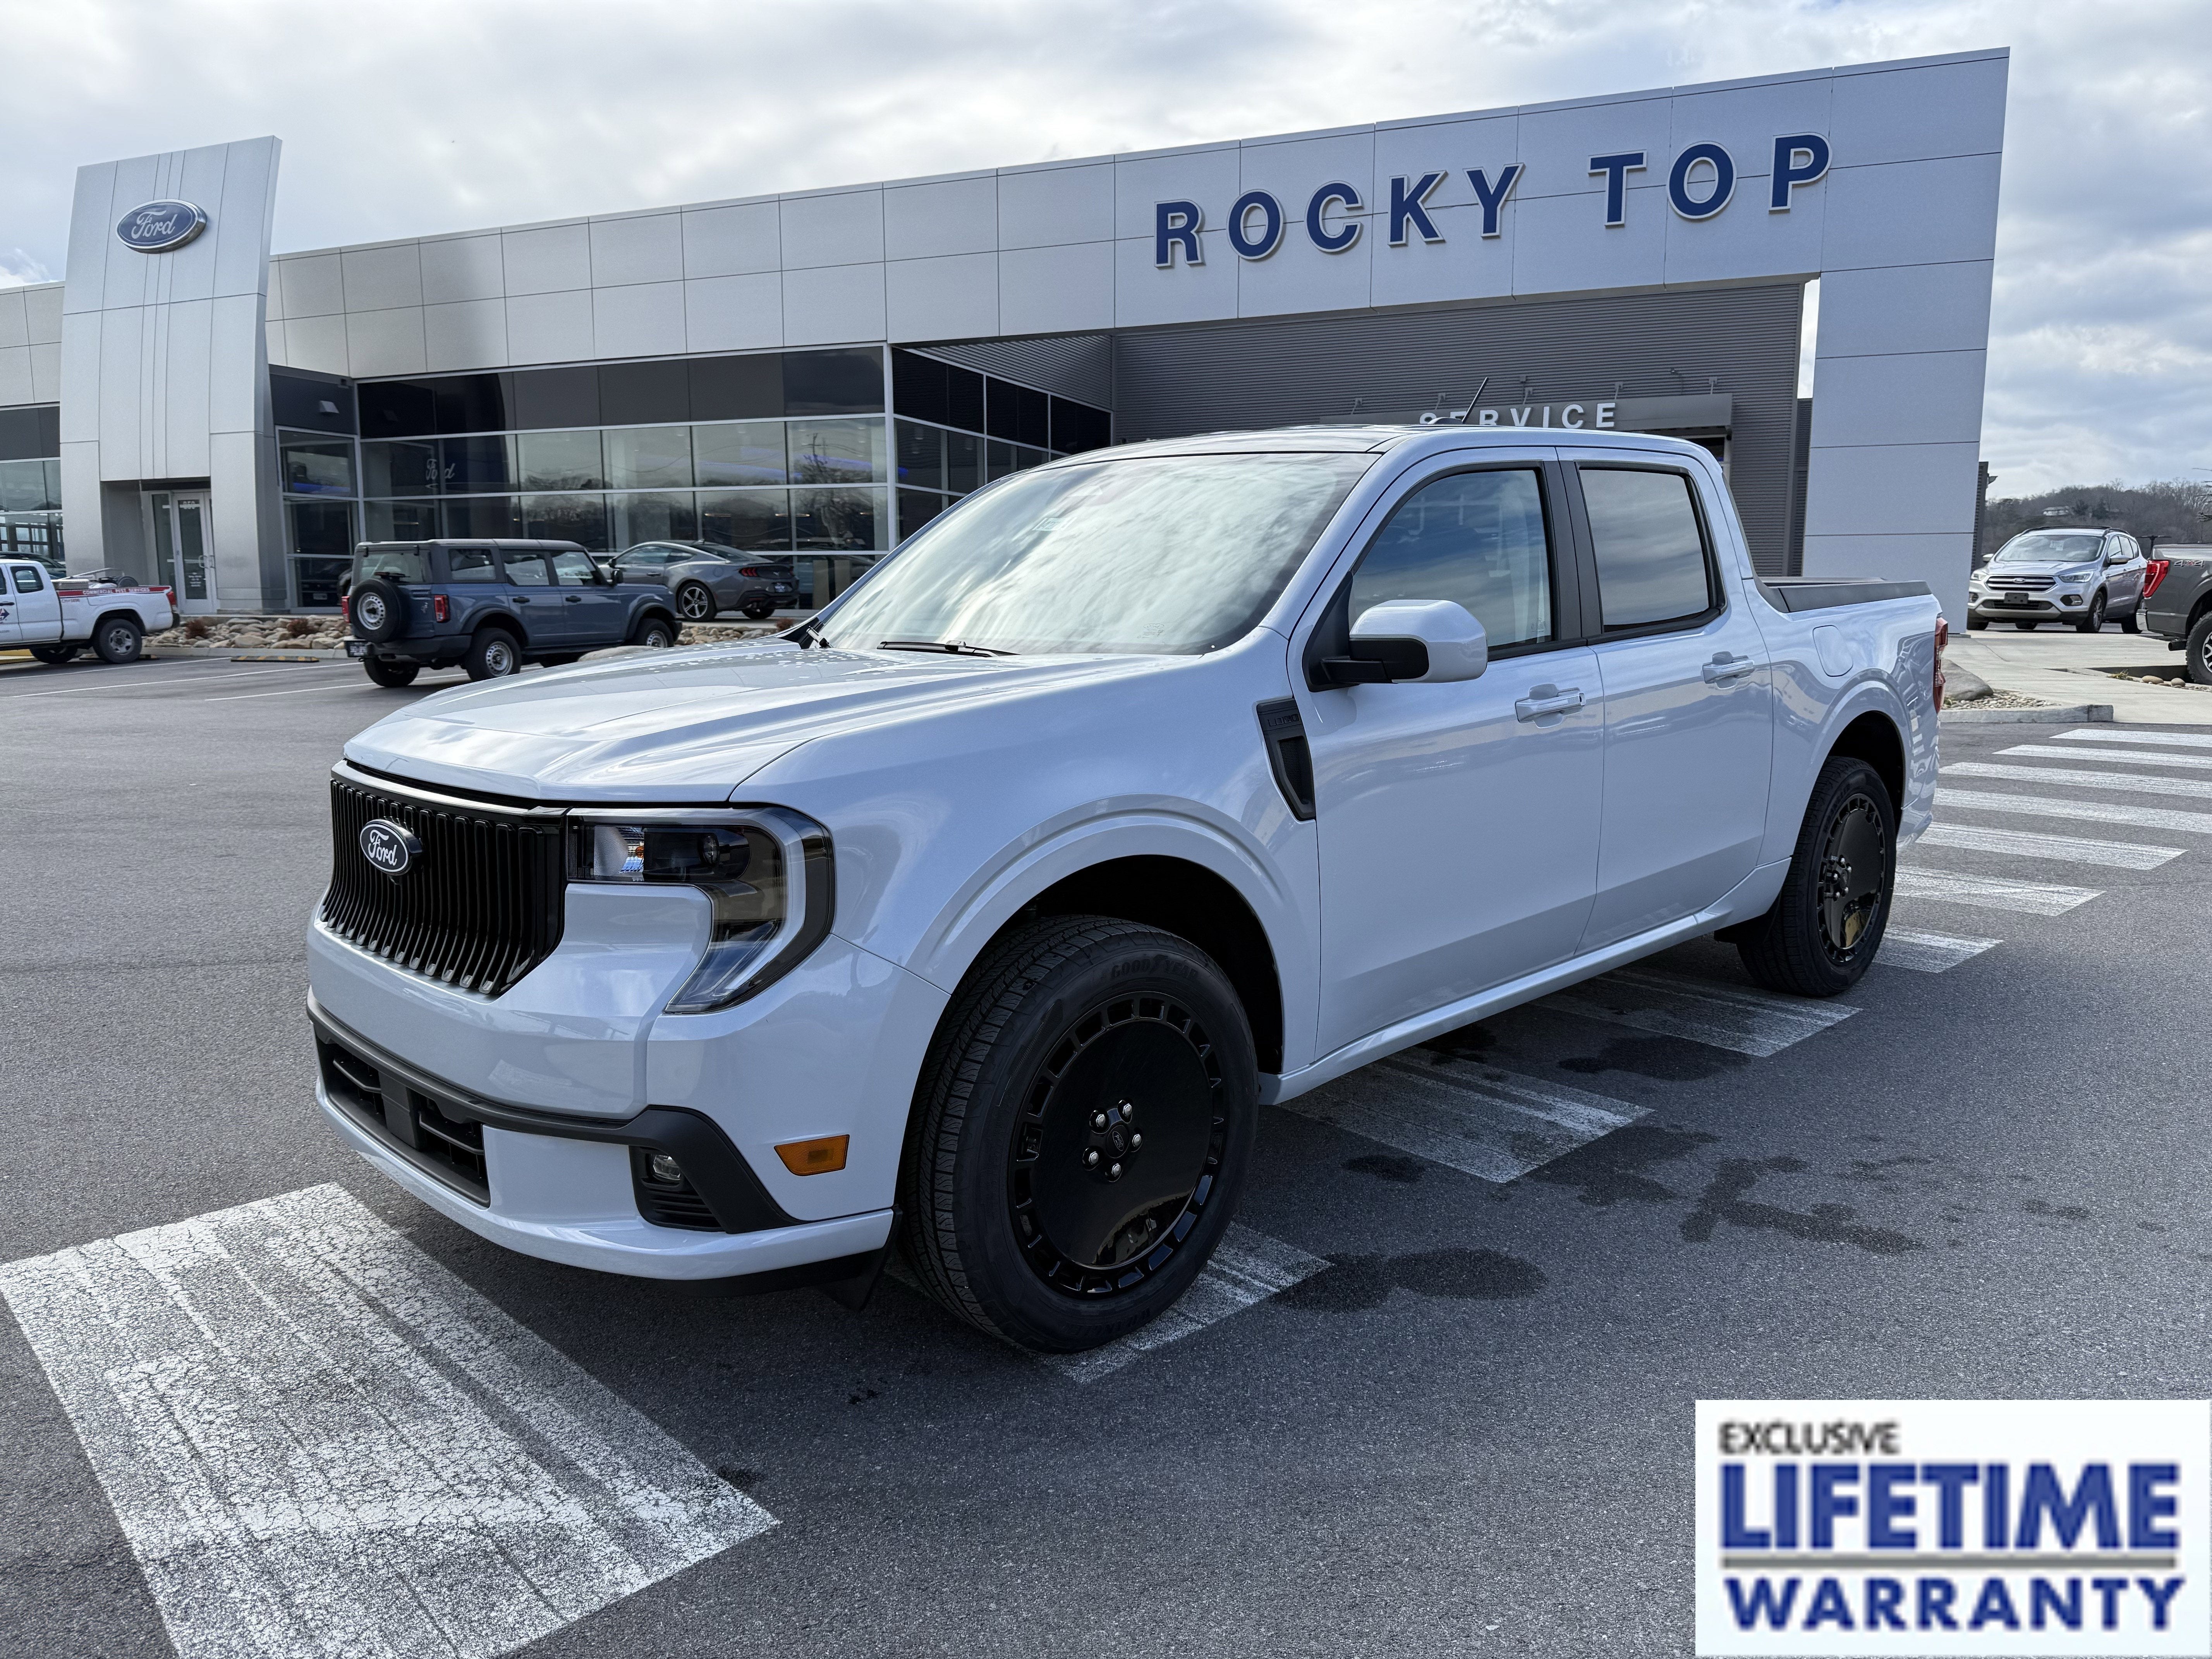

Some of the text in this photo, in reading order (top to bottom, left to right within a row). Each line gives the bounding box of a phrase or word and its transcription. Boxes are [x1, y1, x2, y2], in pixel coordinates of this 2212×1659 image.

[1154, 132, 1832, 268] ROCKY TOP
[131, 210, 179, 239] Ford
[1419, 403, 1616, 429] RVICE
[426, 459, 455, 480] Fod
[1267, 714, 1300, 726] LOBO
[368, 830, 397, 866] Ford
